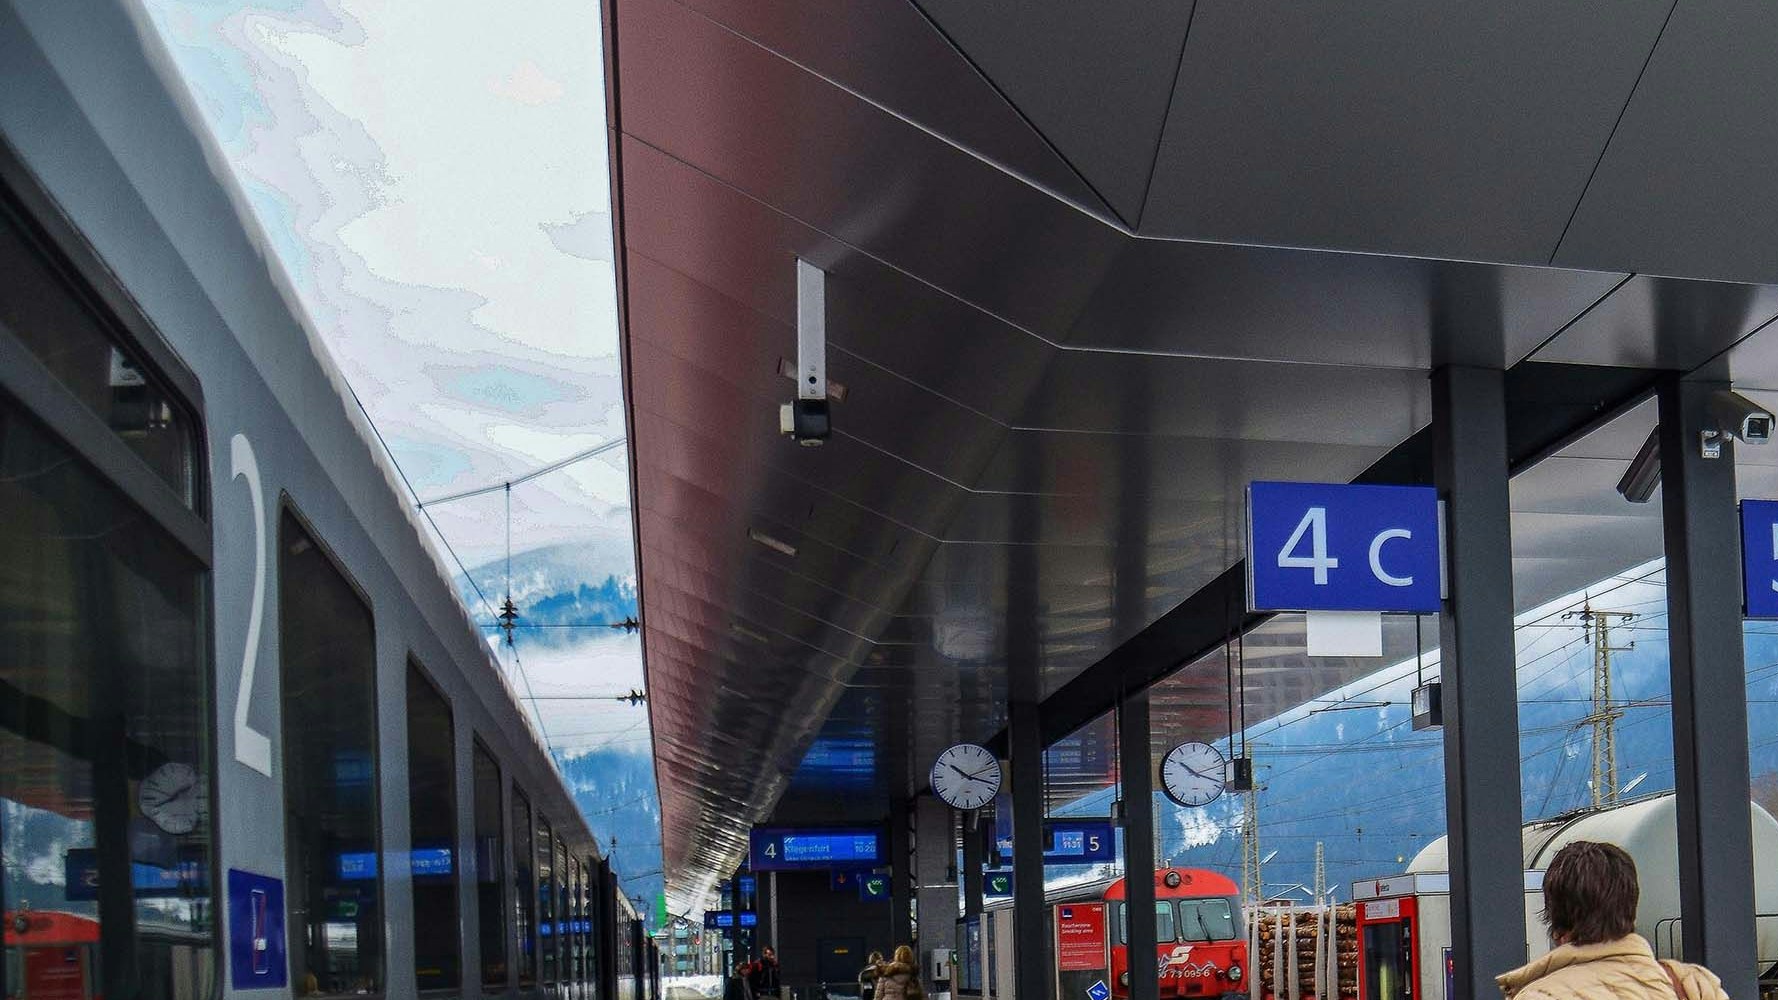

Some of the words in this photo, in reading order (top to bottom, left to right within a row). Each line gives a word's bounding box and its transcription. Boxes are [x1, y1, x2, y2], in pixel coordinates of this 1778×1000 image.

[1277, 507, 1339, 585] 4
[231, 433, 272, 778] 2
[764, 843, 777, 858] 4
[1089, 836, 1100, 851] 5
